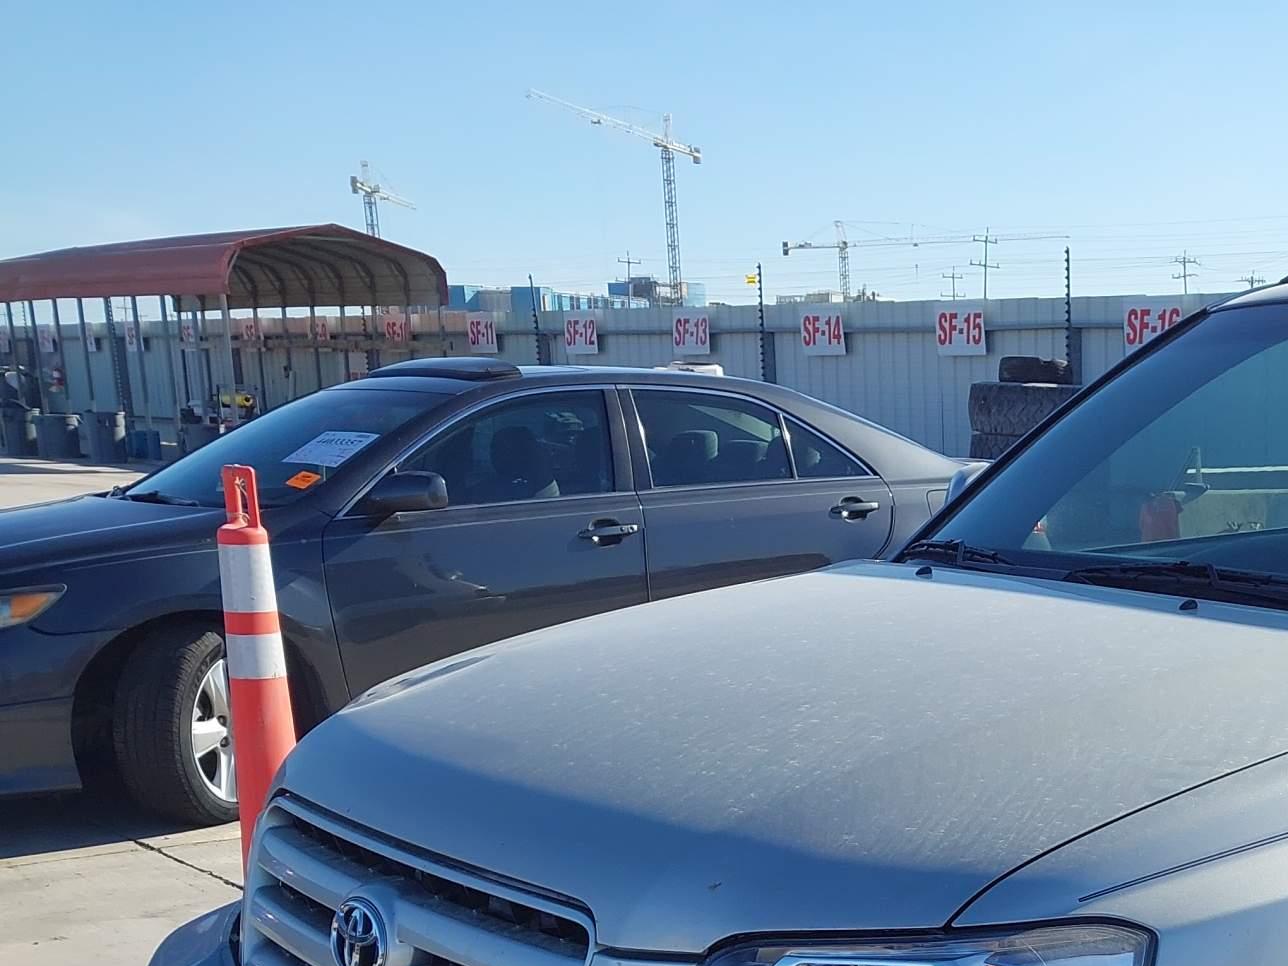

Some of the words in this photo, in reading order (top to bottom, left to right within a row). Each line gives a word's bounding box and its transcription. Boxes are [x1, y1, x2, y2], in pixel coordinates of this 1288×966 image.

[470, 321, 494, 346] SF-11
[566, 320, 595, 346] SF-12
[674, 318, 707, 346] SF-13
[802, 315, 842, 346] SF-14
[937, 312, 982, 345] SF-15
